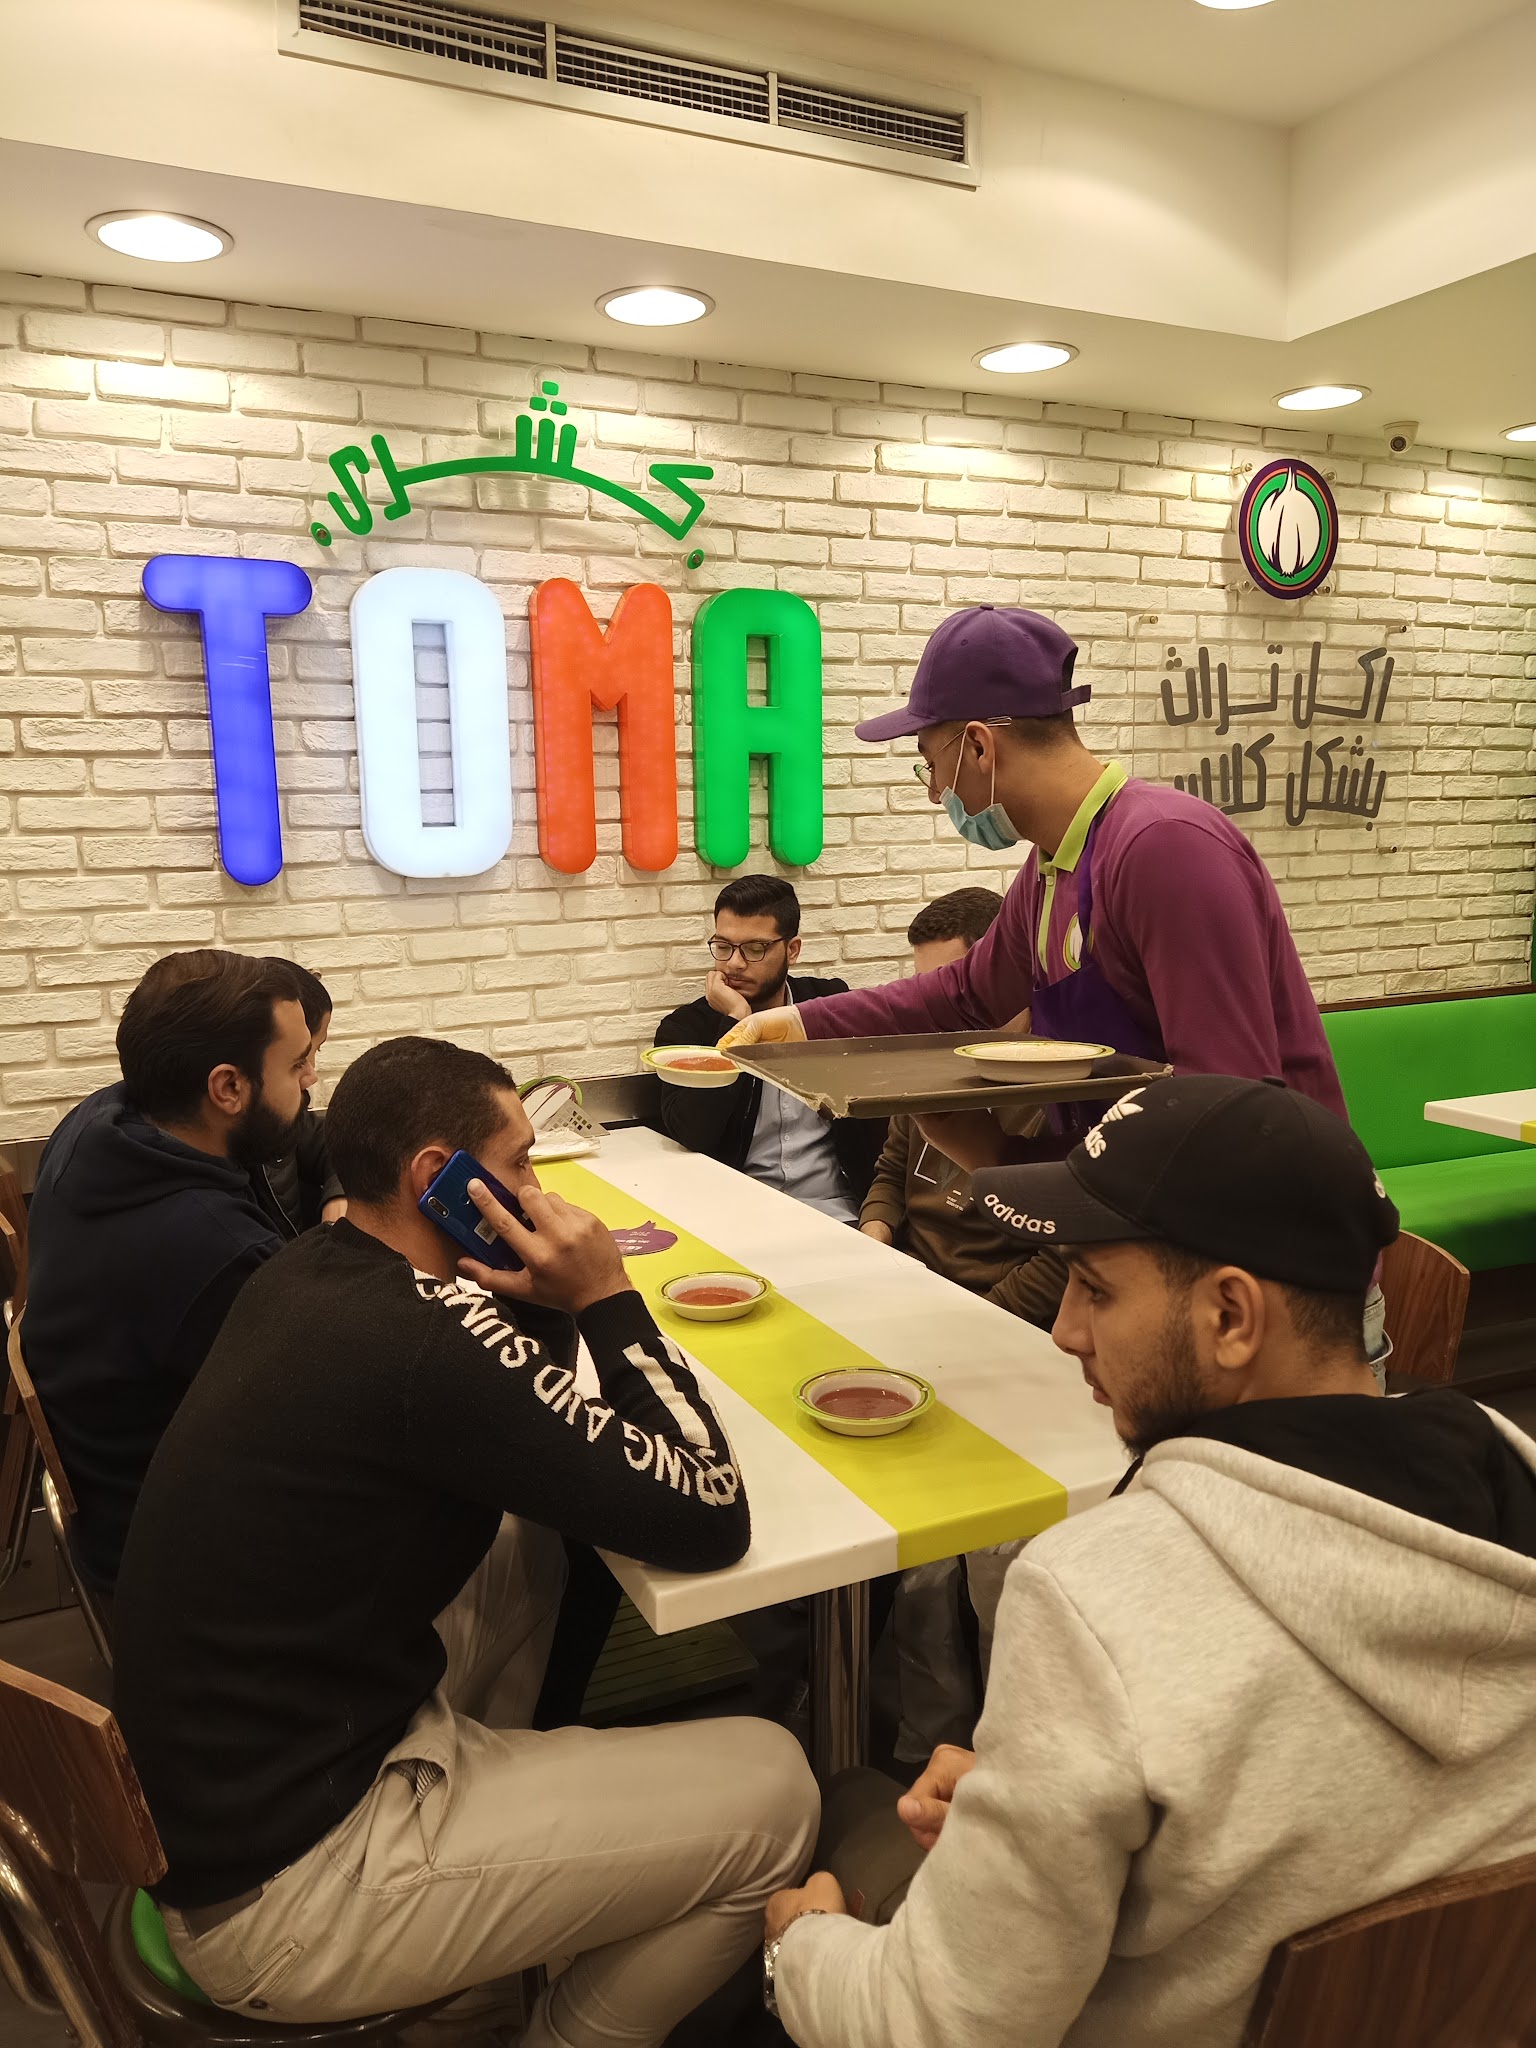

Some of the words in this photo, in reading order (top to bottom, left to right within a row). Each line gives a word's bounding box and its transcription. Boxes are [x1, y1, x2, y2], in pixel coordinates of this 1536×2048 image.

[142, 553, 824, 887] TOMA
[1160, 643, 1283, 735] تراث
[1292, 641, 1395, 730] اكل
[1286, 735, 1387, 831] بشكل
[984, 1194, 1056, 1234] adidas
[533, 1364, 615, 1443] AND
